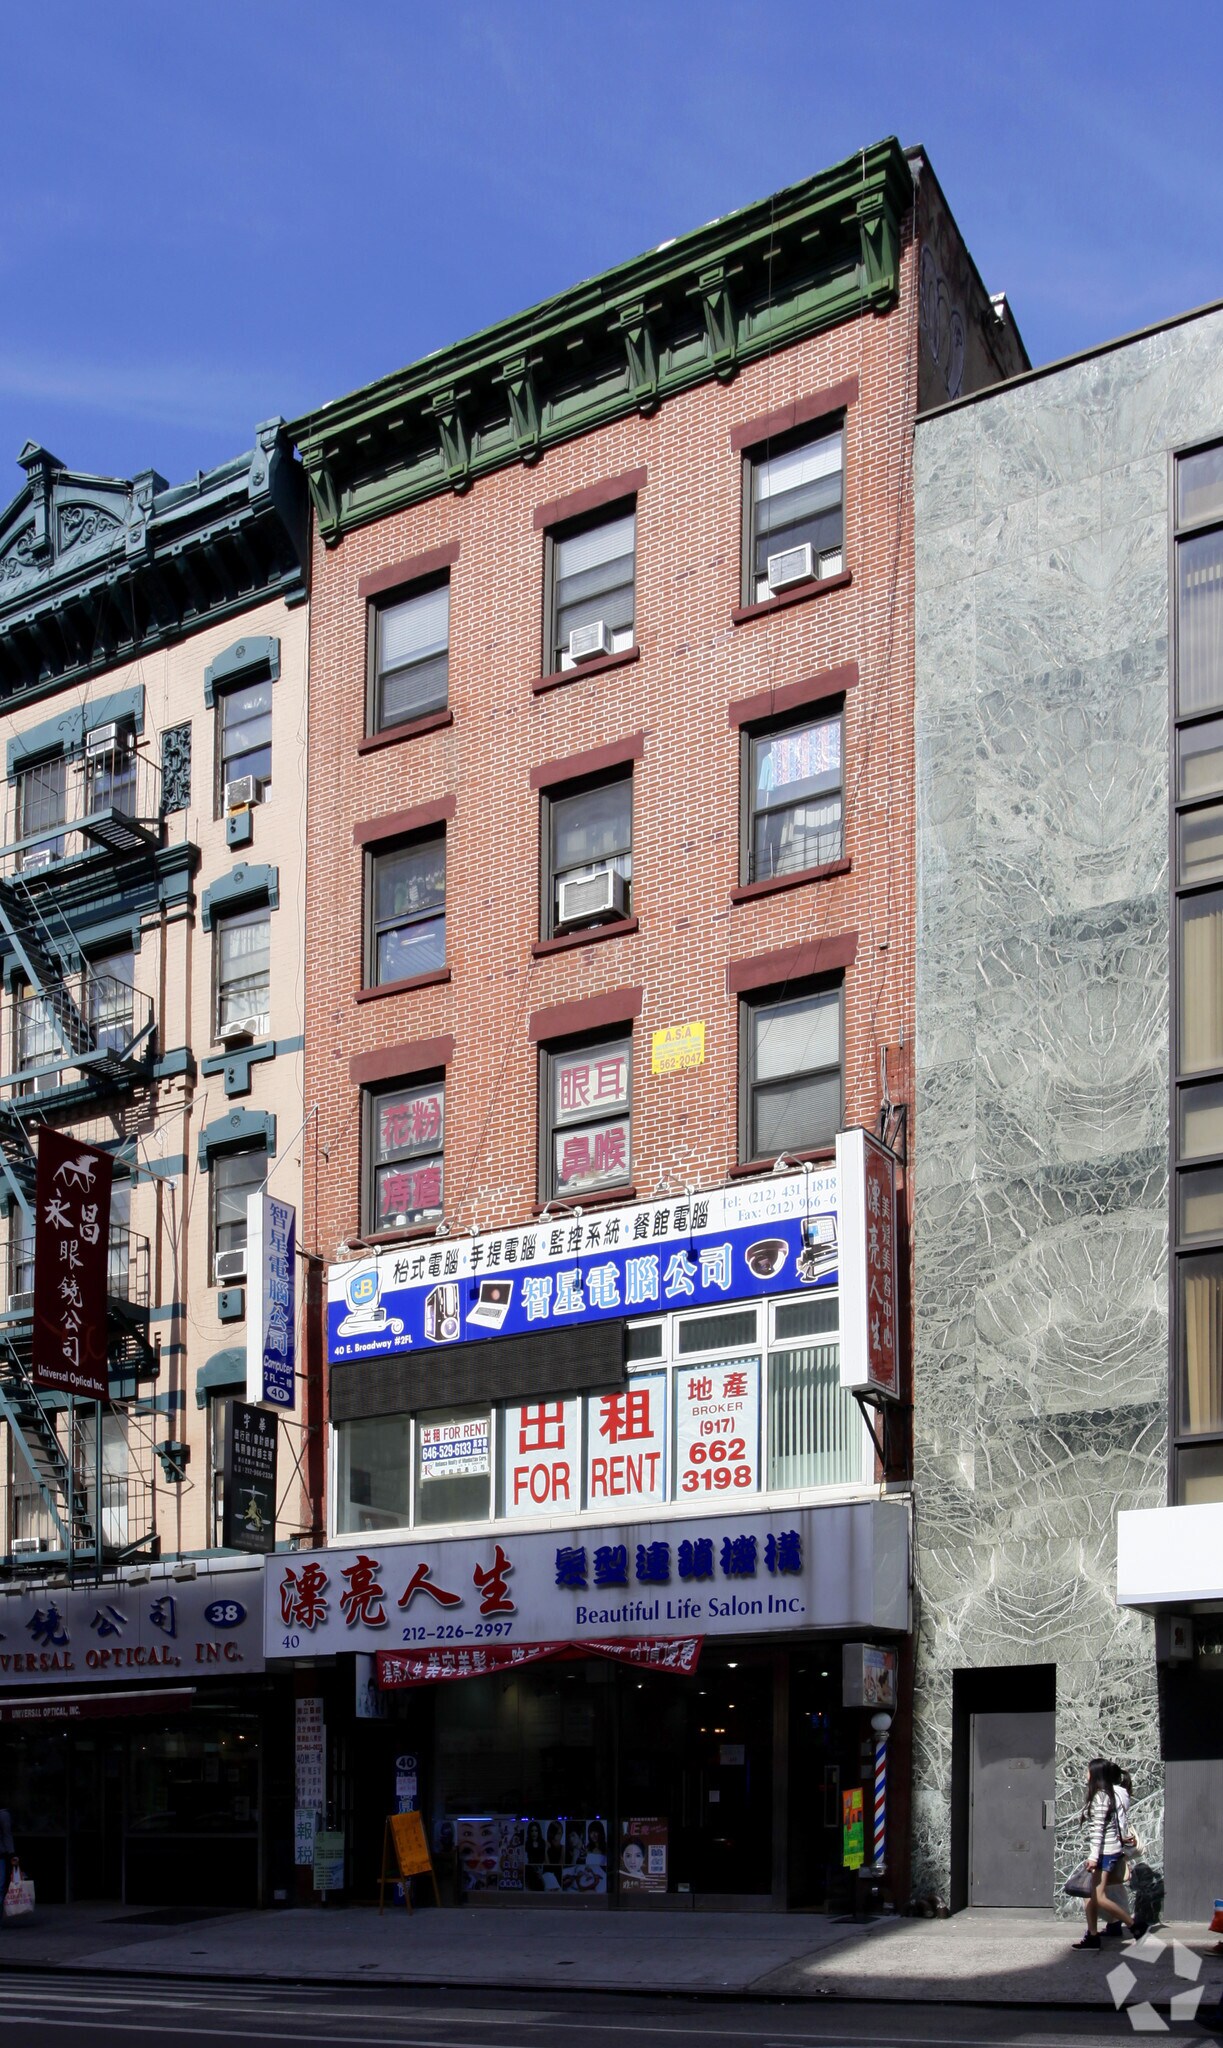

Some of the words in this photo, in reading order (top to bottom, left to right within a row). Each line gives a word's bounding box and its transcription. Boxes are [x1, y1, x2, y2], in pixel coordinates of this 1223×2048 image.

[561, 1057, 625, 1110] 眼耳
[561, 1127, 626, 1182] 鼻喉
[720, 1195, 742, 1211] Tel:
[748, 1188, 776, 1205] (212)
[738, 1210, 763, 1222] Fax:
[765, 1201, 794, 1217] (212)
[866, 1177, 883, 1352] 漂亮人生
[268, 1203, 290, 1357] 智星電腦公司
[521, 1241, 734, 1322] 智星電腦公司
[57, 1239, 84, 1367] 眼鏡公司
[334, 1345, 345, 1356] 40
[346, 1343, 353, 1354] E.
[354, 1339, 392, 1353] Broadway
[394, 1335, 413, 1346] #2FL
[37, 1364, 69, 1383] Universal
[69, 1372, 93, 1389] Optical
[93, 1379, 105, 1392] Inc.
[263, 1354, 293, 1375] Computer
[271, 1388, 285, 1399] 40
[687, 1372, 749, 1401] 地產
[692, 1402, 744, 1417] BROKER
[423, 1428, 440, 1444] 出租
[443, 1426, 461, 1440] FOR
[463, 1422, 487, 1438] RENT
[699, 1417, 736, 1437] (917)
[422, 1442, 472, 1460] 646-529-6133
[689, 1438, 747, 1465] 662
[513, 1462, 570, 1505] FOR
[591, 1452, 661, 1498] RENT
[681, 1465, 753, 1493] 3198
[279, 1545, 517, 1630] 漂亮人生
[0, 1595, 177, 1648] 鏡公司
[211, 1604, 238, 1622] 38
[576, 1600, 660, 1625] Beautiful
[667, 1598, 701, 1620] Life
[708, 1595, 763, 1618] Salon
[768, 1594, 805, 1614] Inc.
[282, 1635, 300, 1649] 40
[402, 1622, 513, 1642] 212-226-2997
[0, 1651, 74, 1673] VERSAL
[85, 1645, 182, 1668] OPTICAL,
[194, 1641, 244, 1664] INC.
[12, 1708, 42, 1719] UNIVERSAL
[398, 1757, 414, 1768] 40
